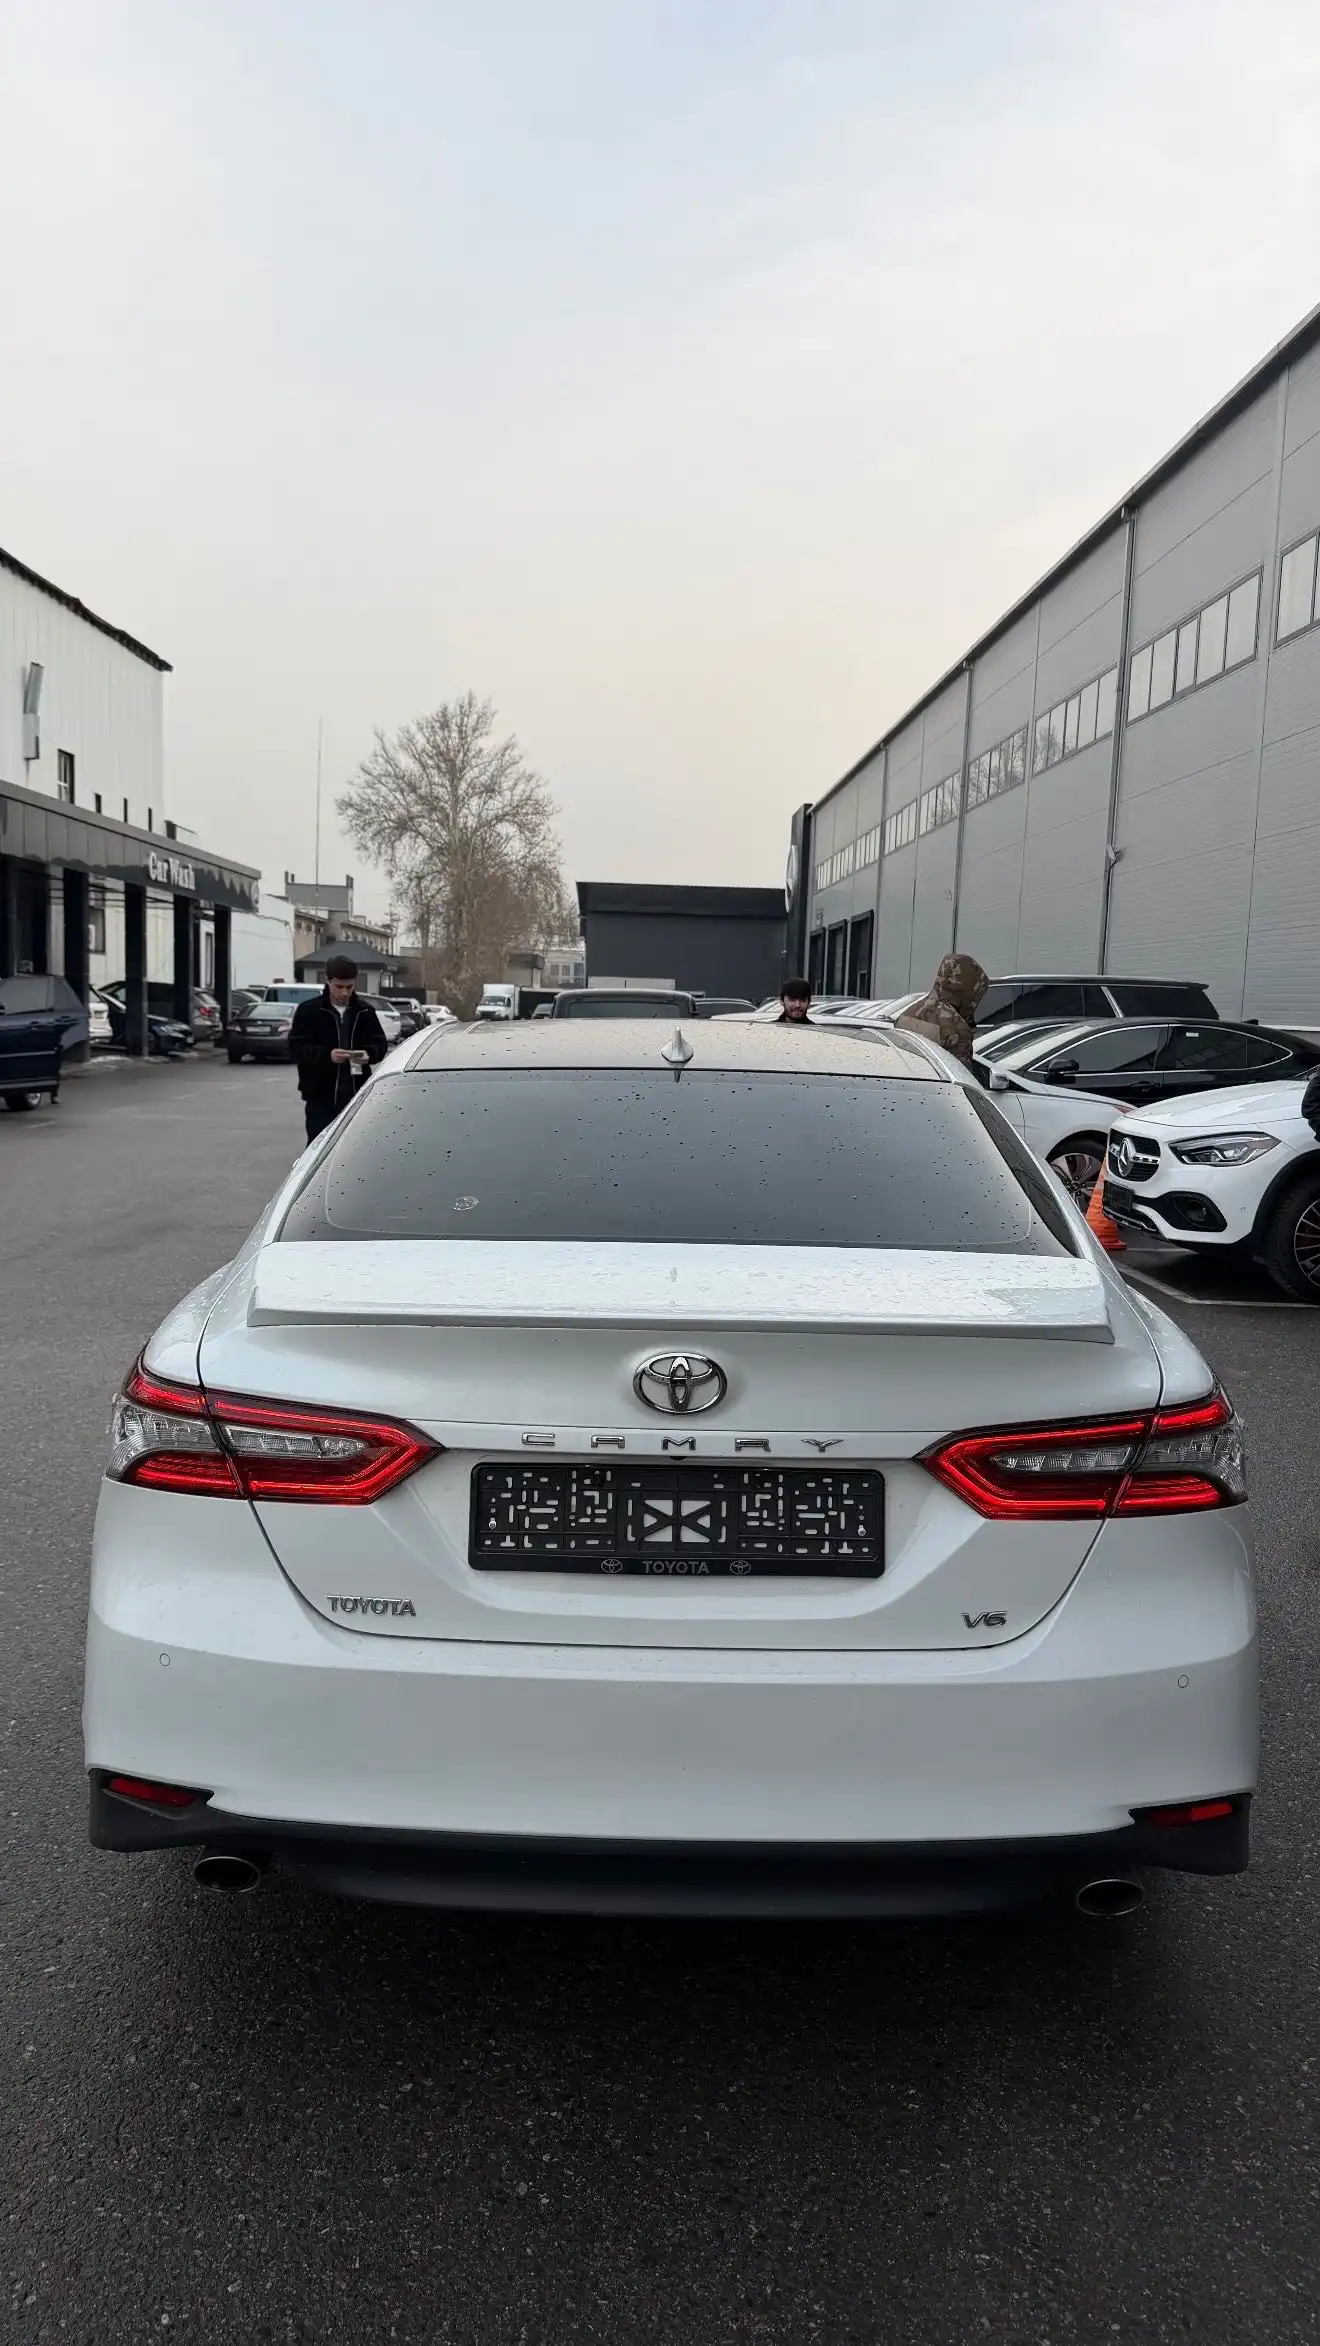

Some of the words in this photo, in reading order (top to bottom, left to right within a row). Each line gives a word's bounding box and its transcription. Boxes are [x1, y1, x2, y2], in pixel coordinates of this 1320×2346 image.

[148, 852, 168, 882] Car
[168, 857, 196, 890] Wash
[521, 1431, 845, 1454] CAMRY
[642, 1560, 710, 1574] TOYOTA
[326, 1595, 416, 1617] TOYOTA
[961, 1610, 1008, 1628] V6
